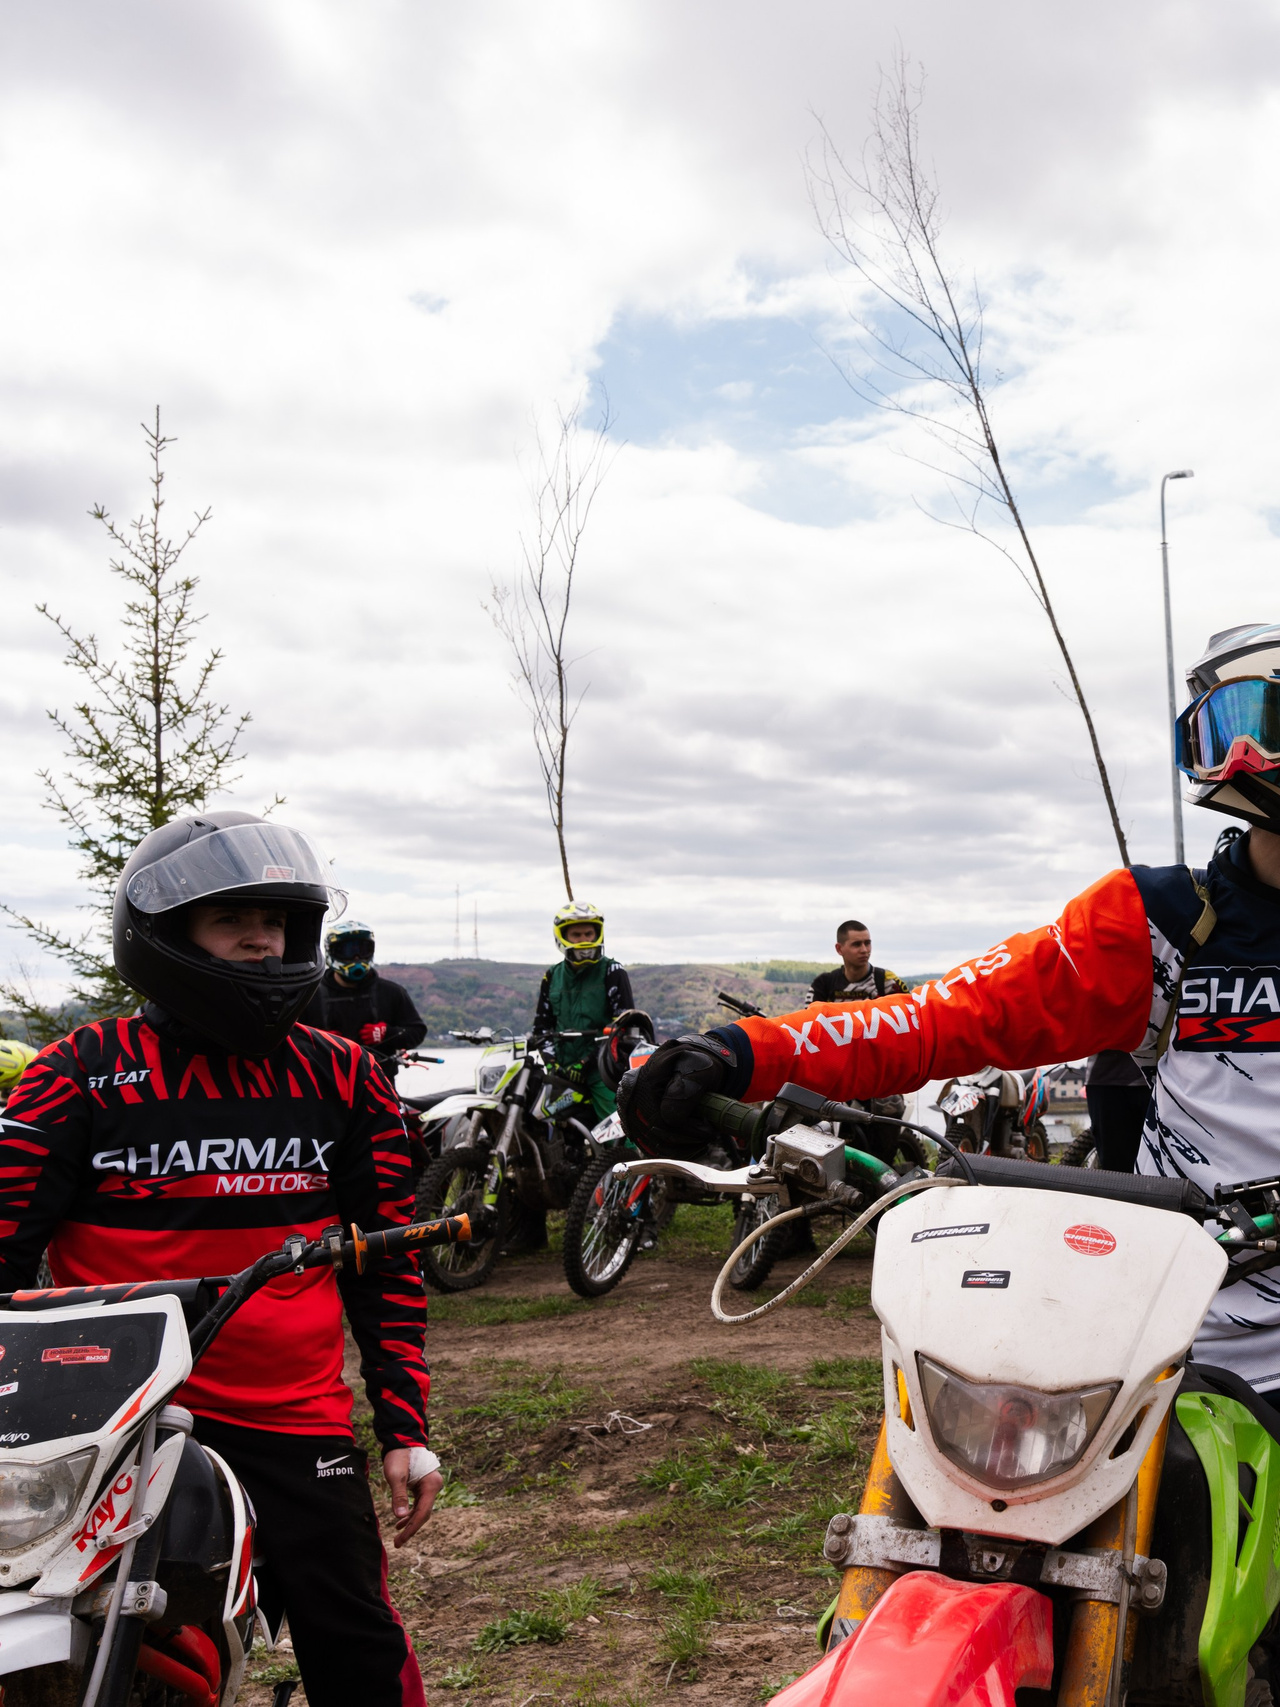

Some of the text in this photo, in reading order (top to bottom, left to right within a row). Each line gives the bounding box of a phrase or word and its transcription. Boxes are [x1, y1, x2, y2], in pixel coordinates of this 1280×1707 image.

[113, 1069, 151, 1086] CAT
[92, 1138, 335, 1175] SHARMAX
[216, 1174, 328, 1194] MOTORS
[403, 1223, 441, 1240] KTM
[914, 1225, 985, 1241] SHARMAX
[317, 1469, 335, 1478] JUST
[336, 1467, 346, 1475] DO
